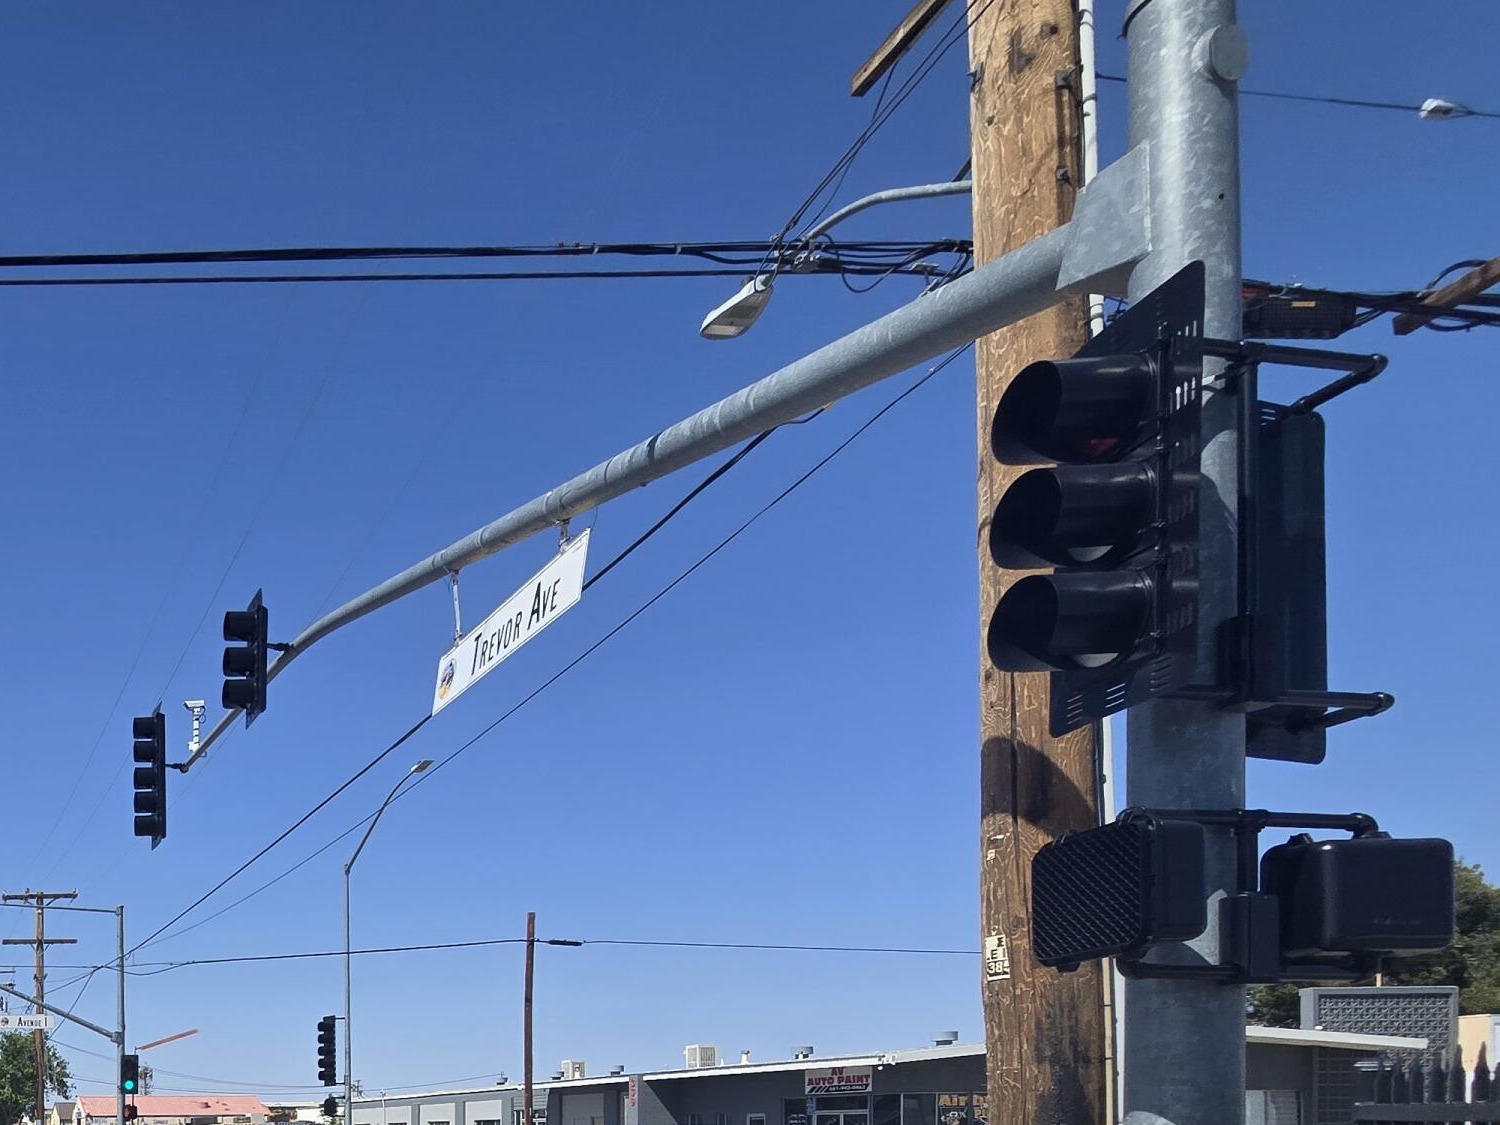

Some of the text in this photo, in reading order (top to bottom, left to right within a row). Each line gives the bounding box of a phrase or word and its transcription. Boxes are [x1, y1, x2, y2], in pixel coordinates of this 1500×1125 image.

[471, 578, 561, 676] TREVOR AVE
[807, 1074, 870, 1086] AUTO PAINT
